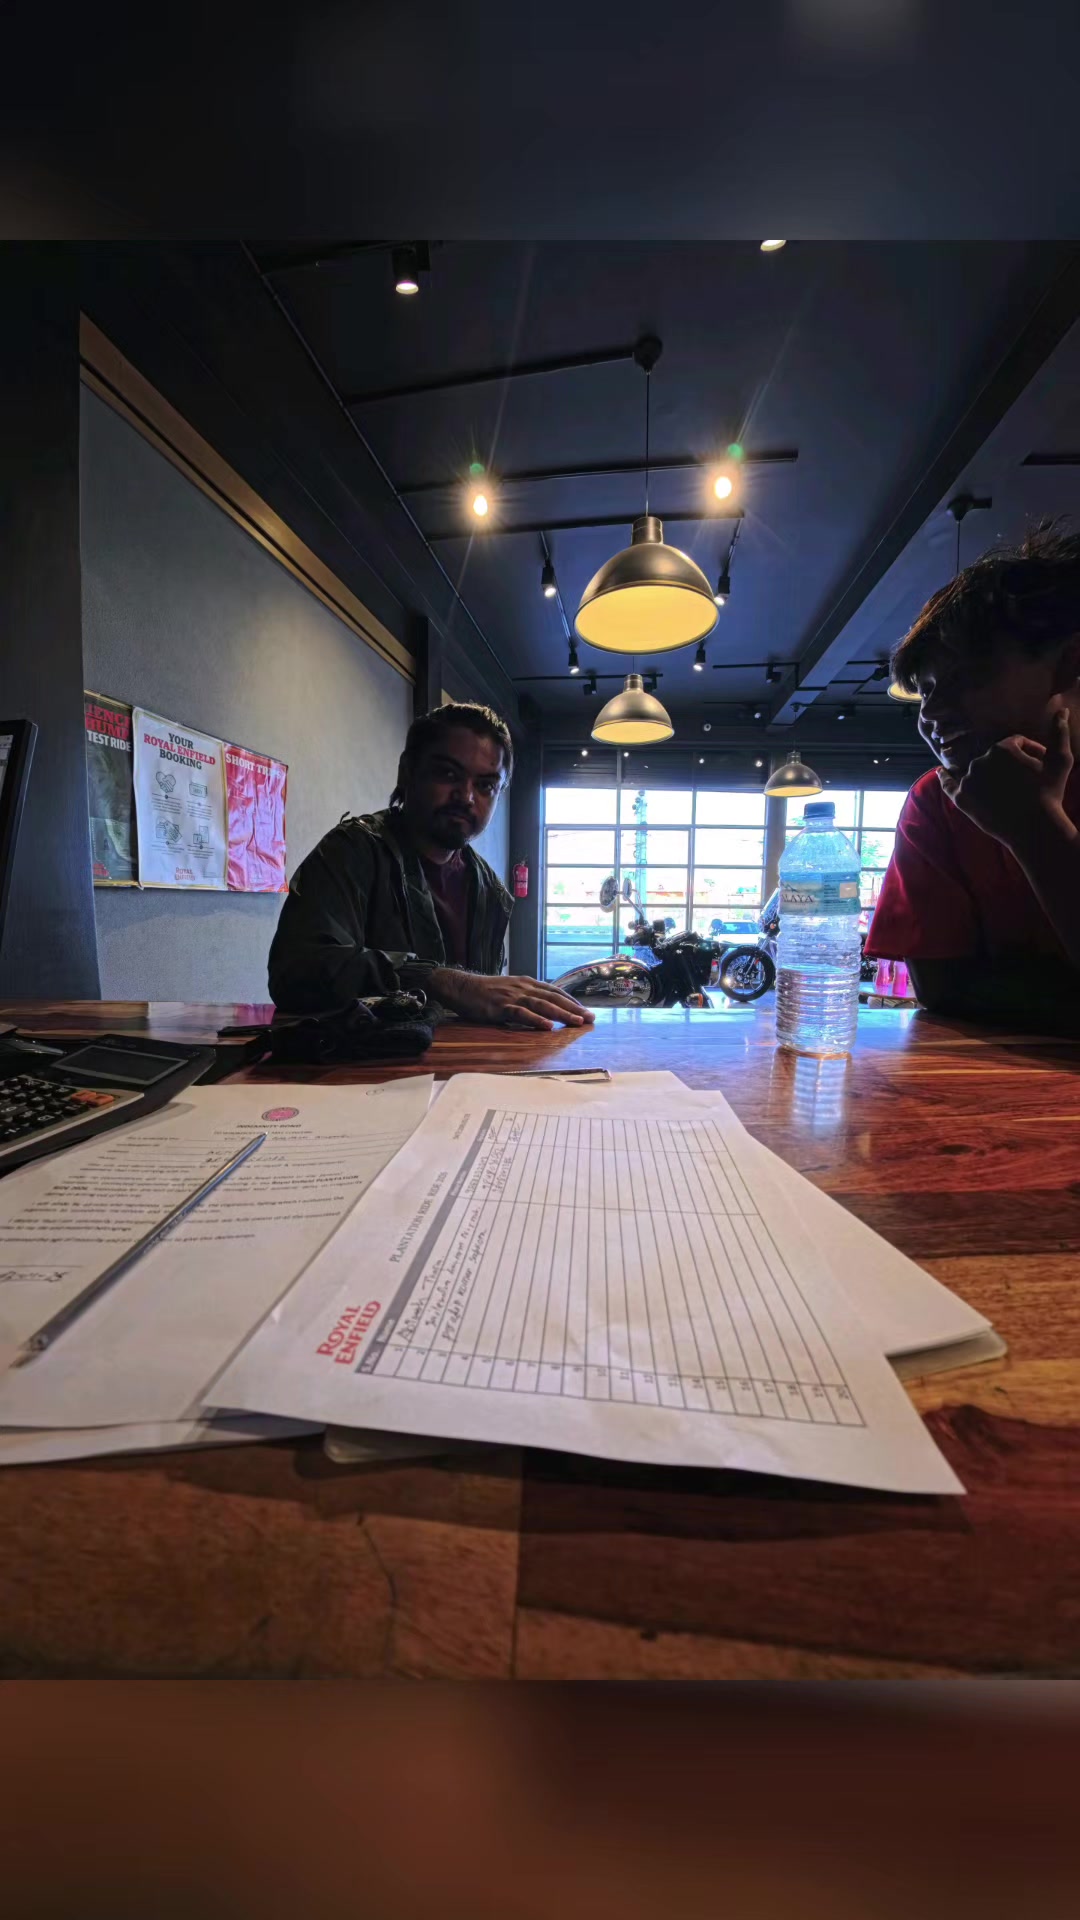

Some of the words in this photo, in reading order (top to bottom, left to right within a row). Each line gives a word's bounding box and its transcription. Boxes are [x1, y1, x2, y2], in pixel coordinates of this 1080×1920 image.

[87, 729, 109, 747] TEST
[110, 736, 132, 753] RIDE
[143, 732, 176, 753] ROYAL
[177, 744, 216, 766] ENFIELD
[168, 732, 194, 750] YOUR
[159, 748, 203, 771] BOOKING
[225, 752, 256, 772] SHORT
[389, 1215, 424, 1263] PLANTATION
[316, 1305, 361, 1356] ROYAL
[335, 1300, 381, 1365] ENFIELD
